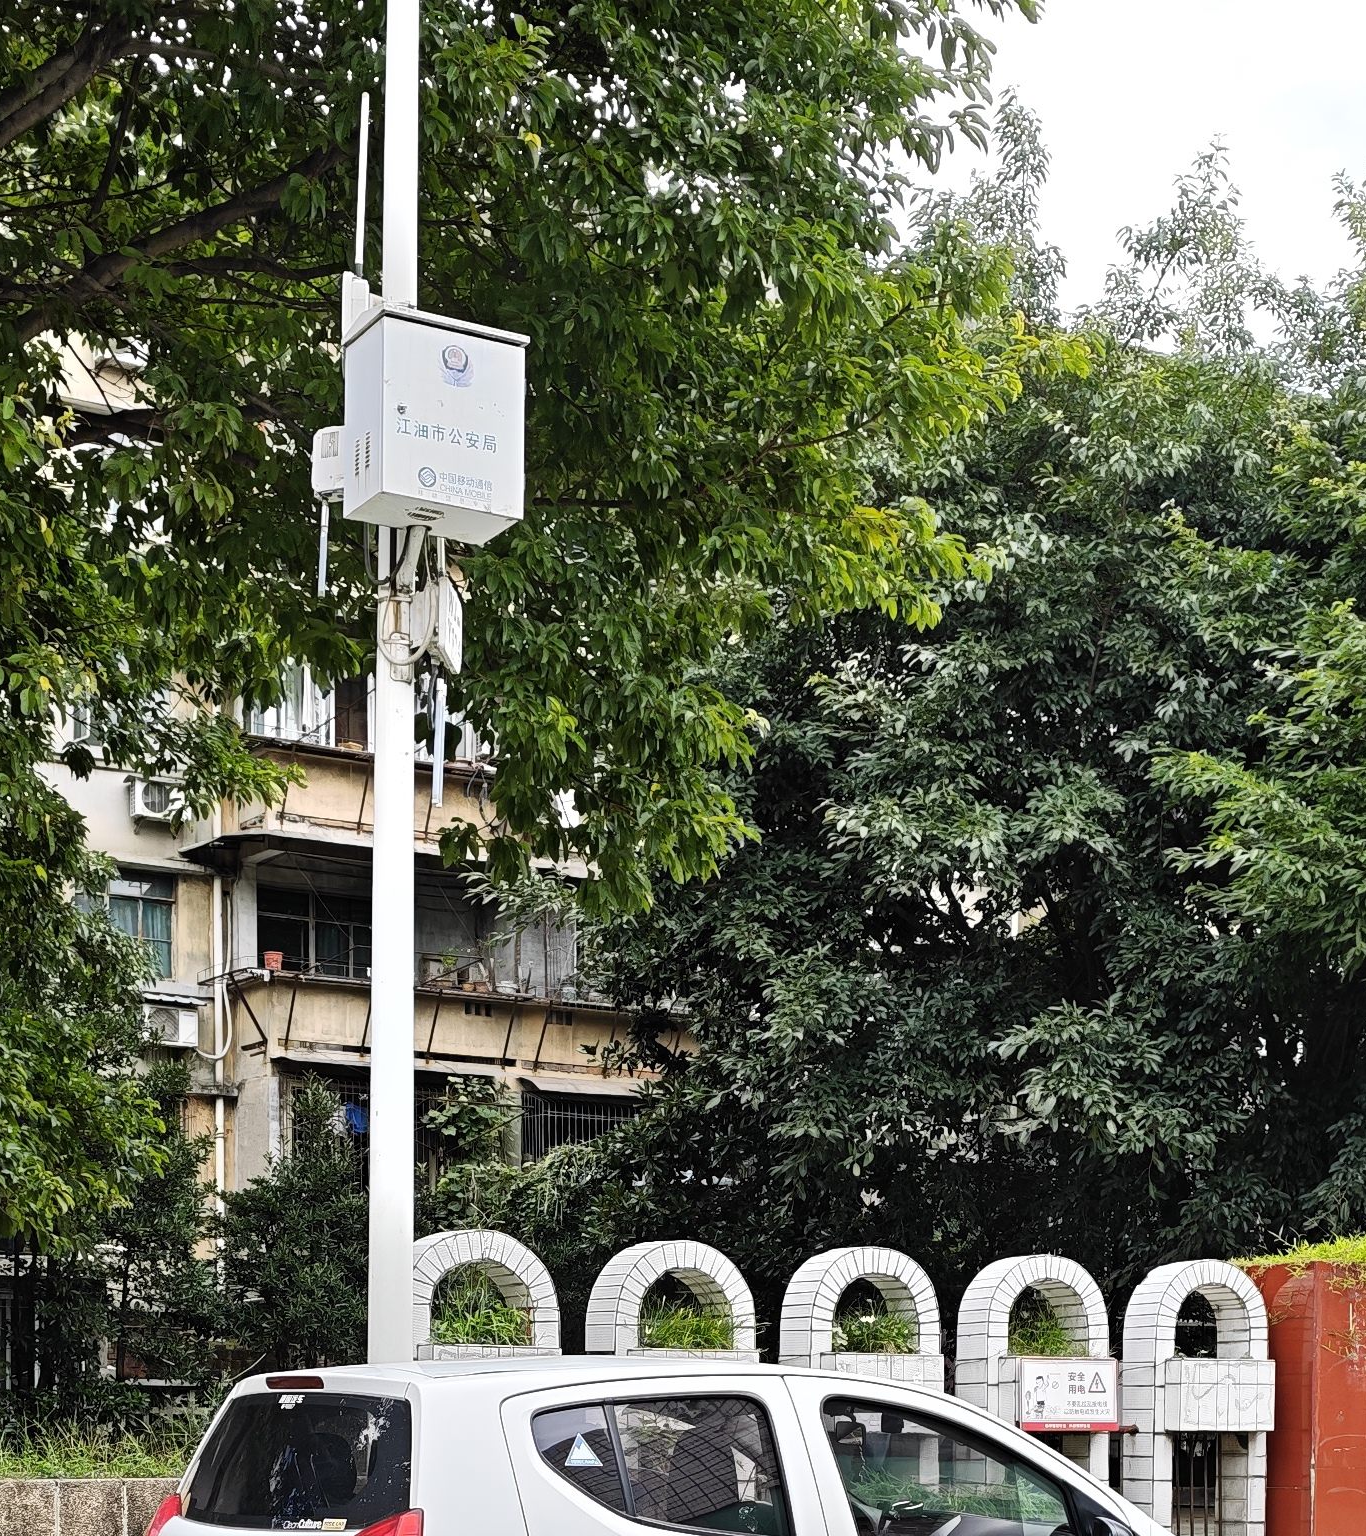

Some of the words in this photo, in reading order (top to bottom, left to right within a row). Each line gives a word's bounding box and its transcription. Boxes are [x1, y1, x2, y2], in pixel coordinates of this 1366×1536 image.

[396, 416, 497, 454] 江油市公安局
[439, 472, 493, 492] 中国移动通信
[439, 483, 464, 496] CHINA
[464, 488, 492, 500] MOBILE
[1067, 1371, 1086, 1382] 安全
[1068, 1384, 1086, 1395] 用电
